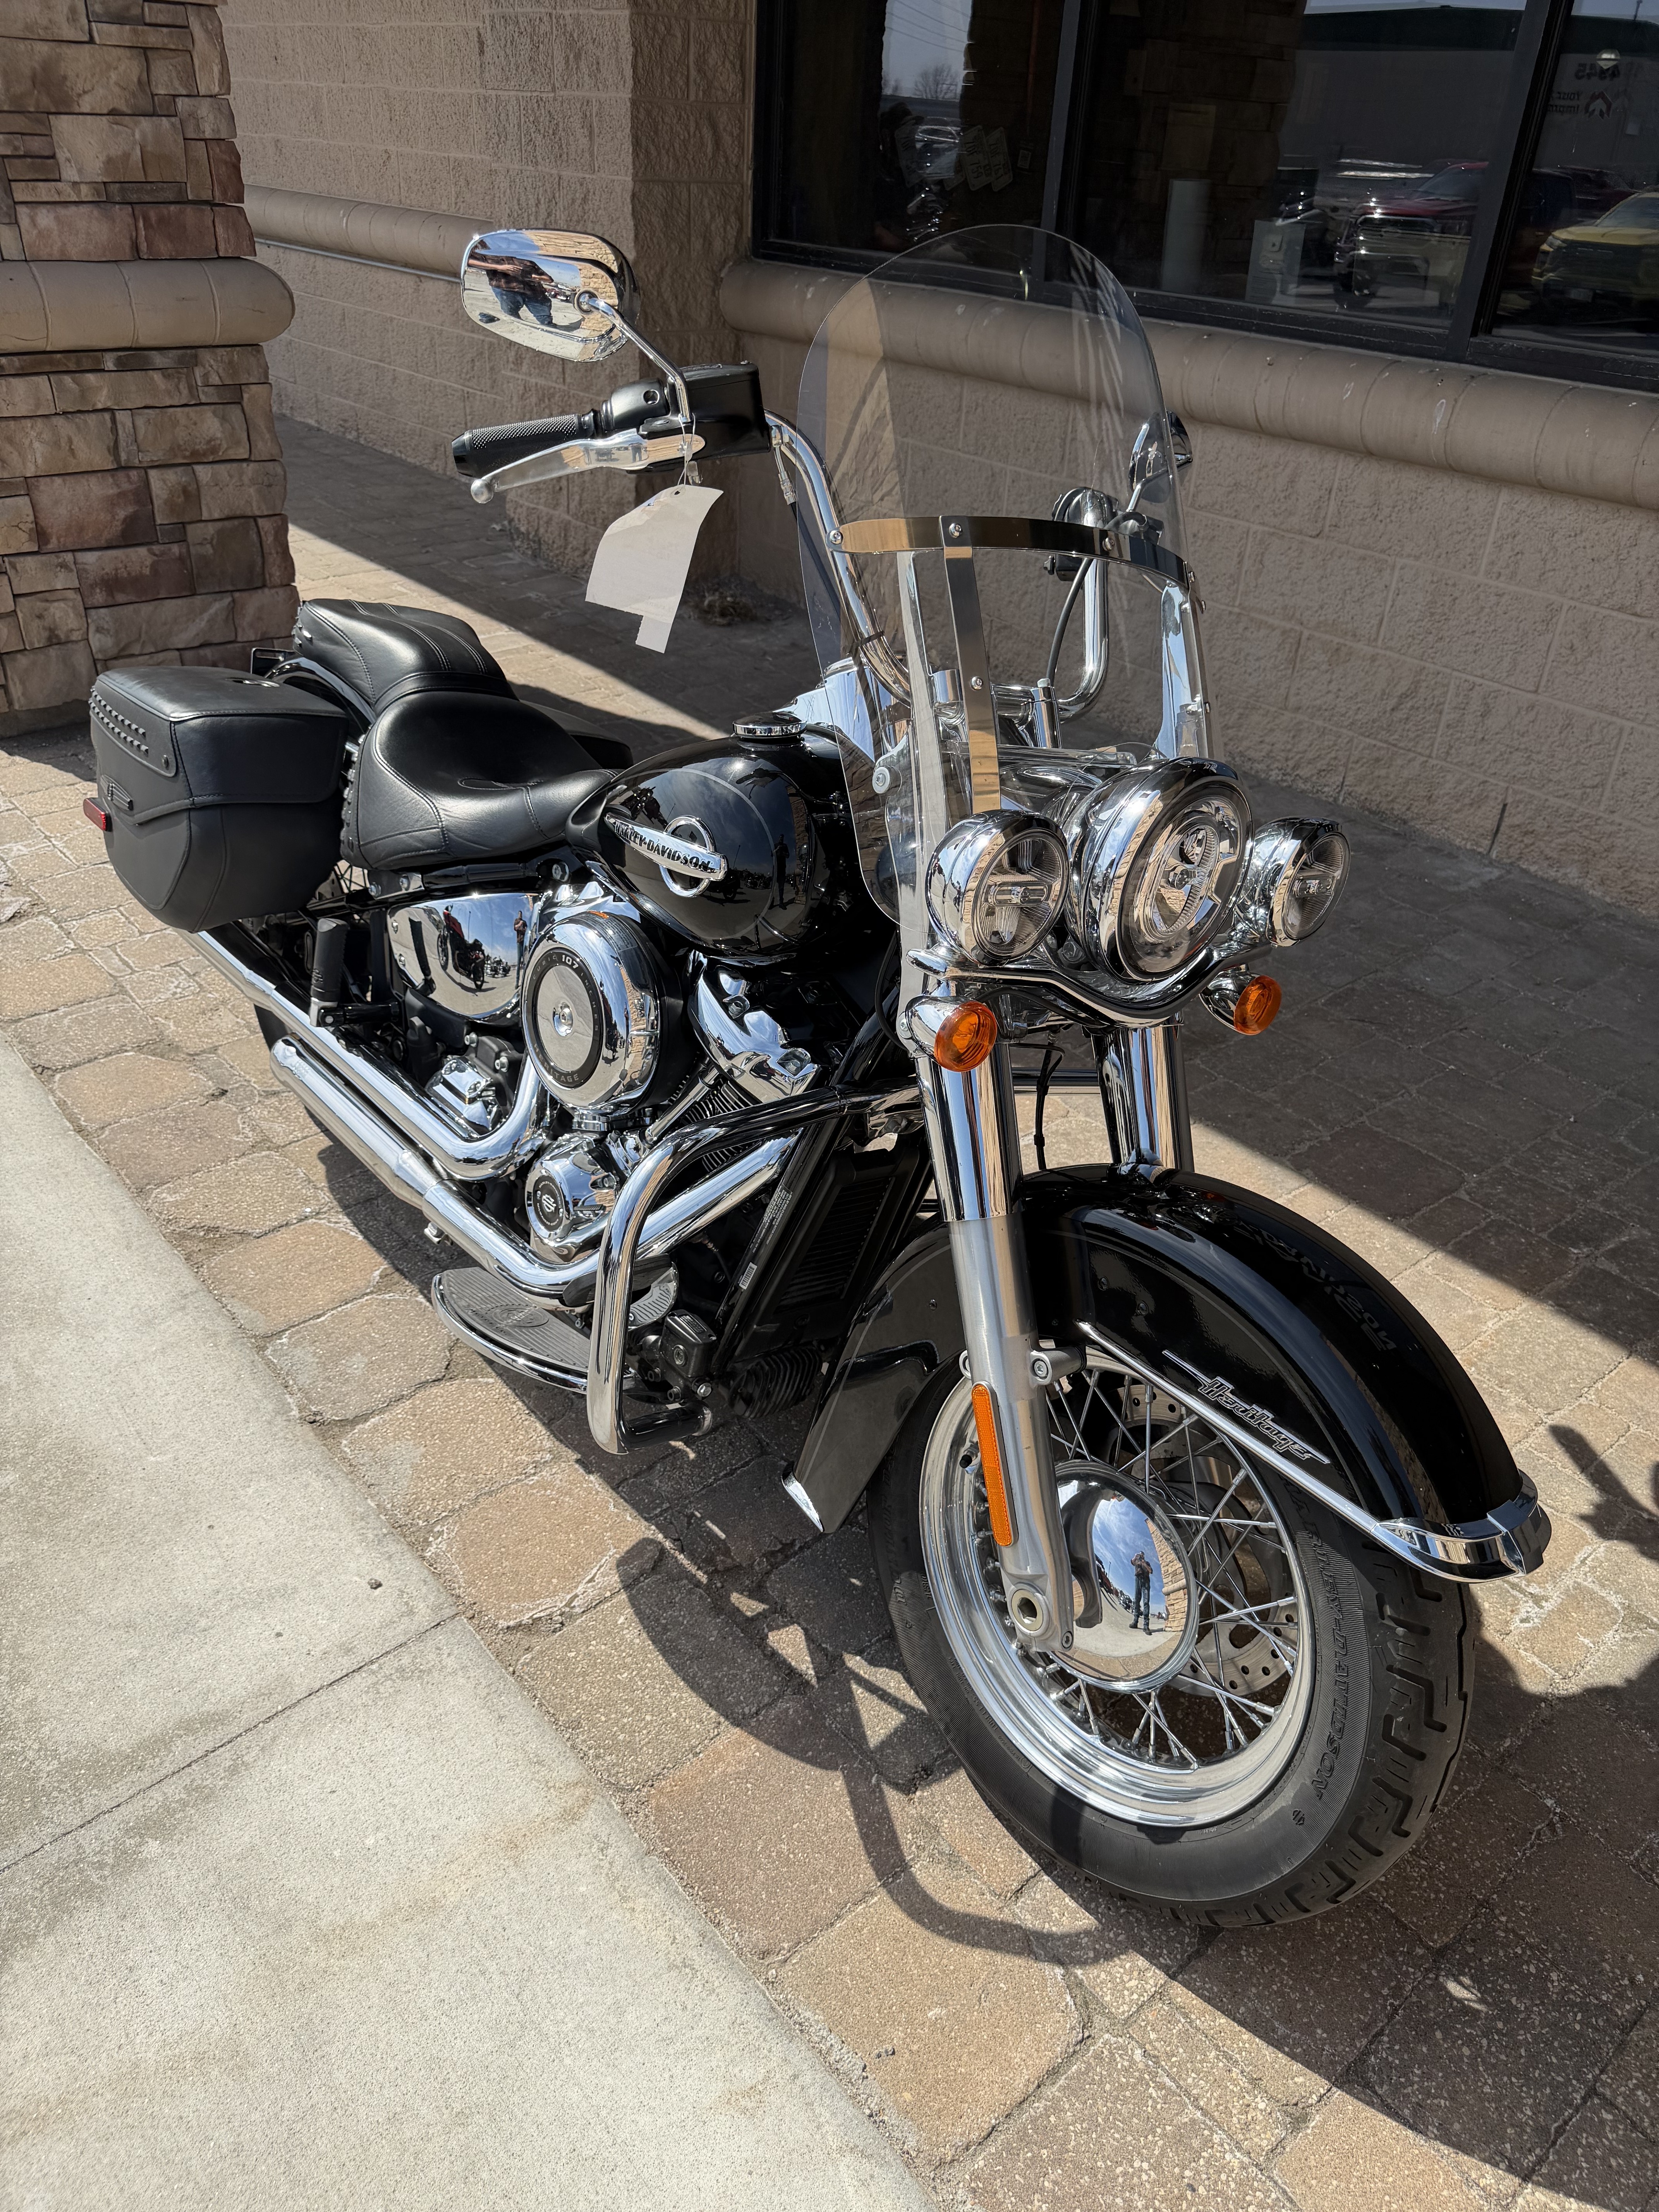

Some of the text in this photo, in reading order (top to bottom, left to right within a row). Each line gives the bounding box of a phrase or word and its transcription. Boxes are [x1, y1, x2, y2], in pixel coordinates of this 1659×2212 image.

[615, 820, 711, 872] HARLEY-DAVIDSON
[533, 953, 598, 1031] CUBIC 107 INCHES
[534, 1044, 579, 1083] HERITAGE
[1198, 1376, 1312, 1460] Heritage
